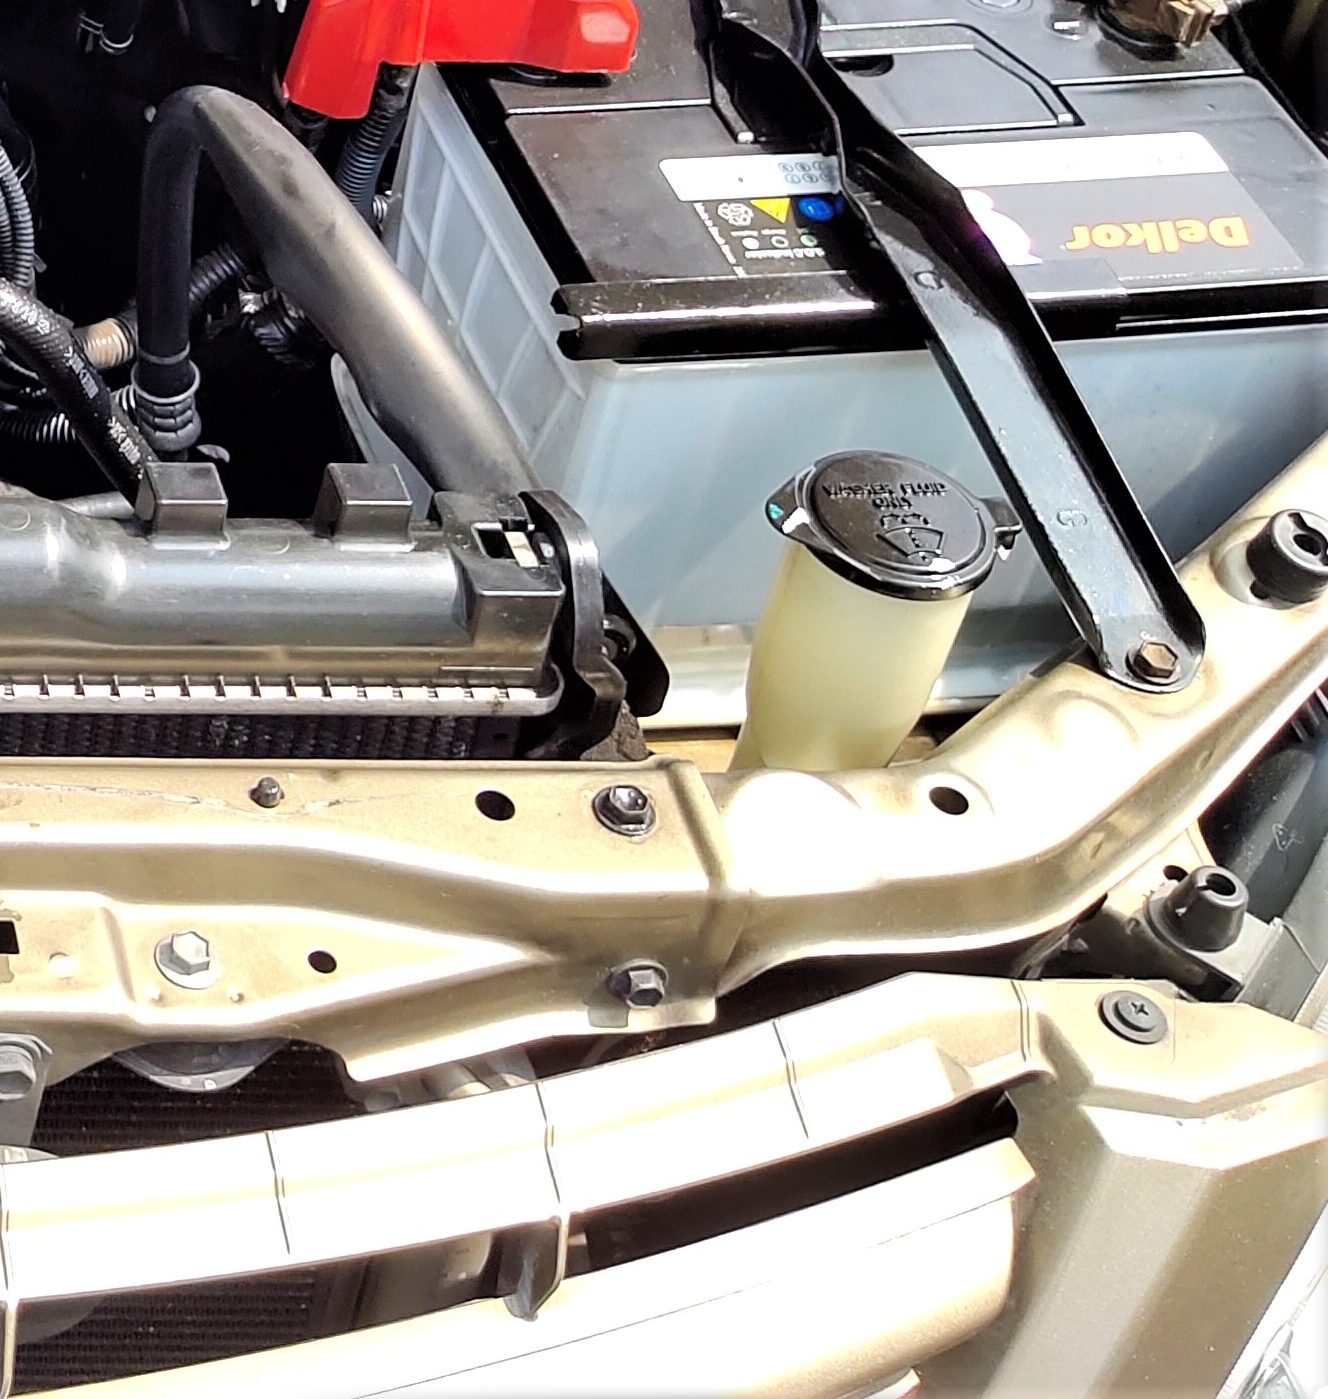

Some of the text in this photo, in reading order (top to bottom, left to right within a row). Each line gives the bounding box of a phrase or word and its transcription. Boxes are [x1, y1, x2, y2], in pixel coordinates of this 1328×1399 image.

[1065, 215, 1250, 254] Delkor
[822, 481, 948, 500] WASHER FLUID
[872, 495, 913, 510] ONLY
